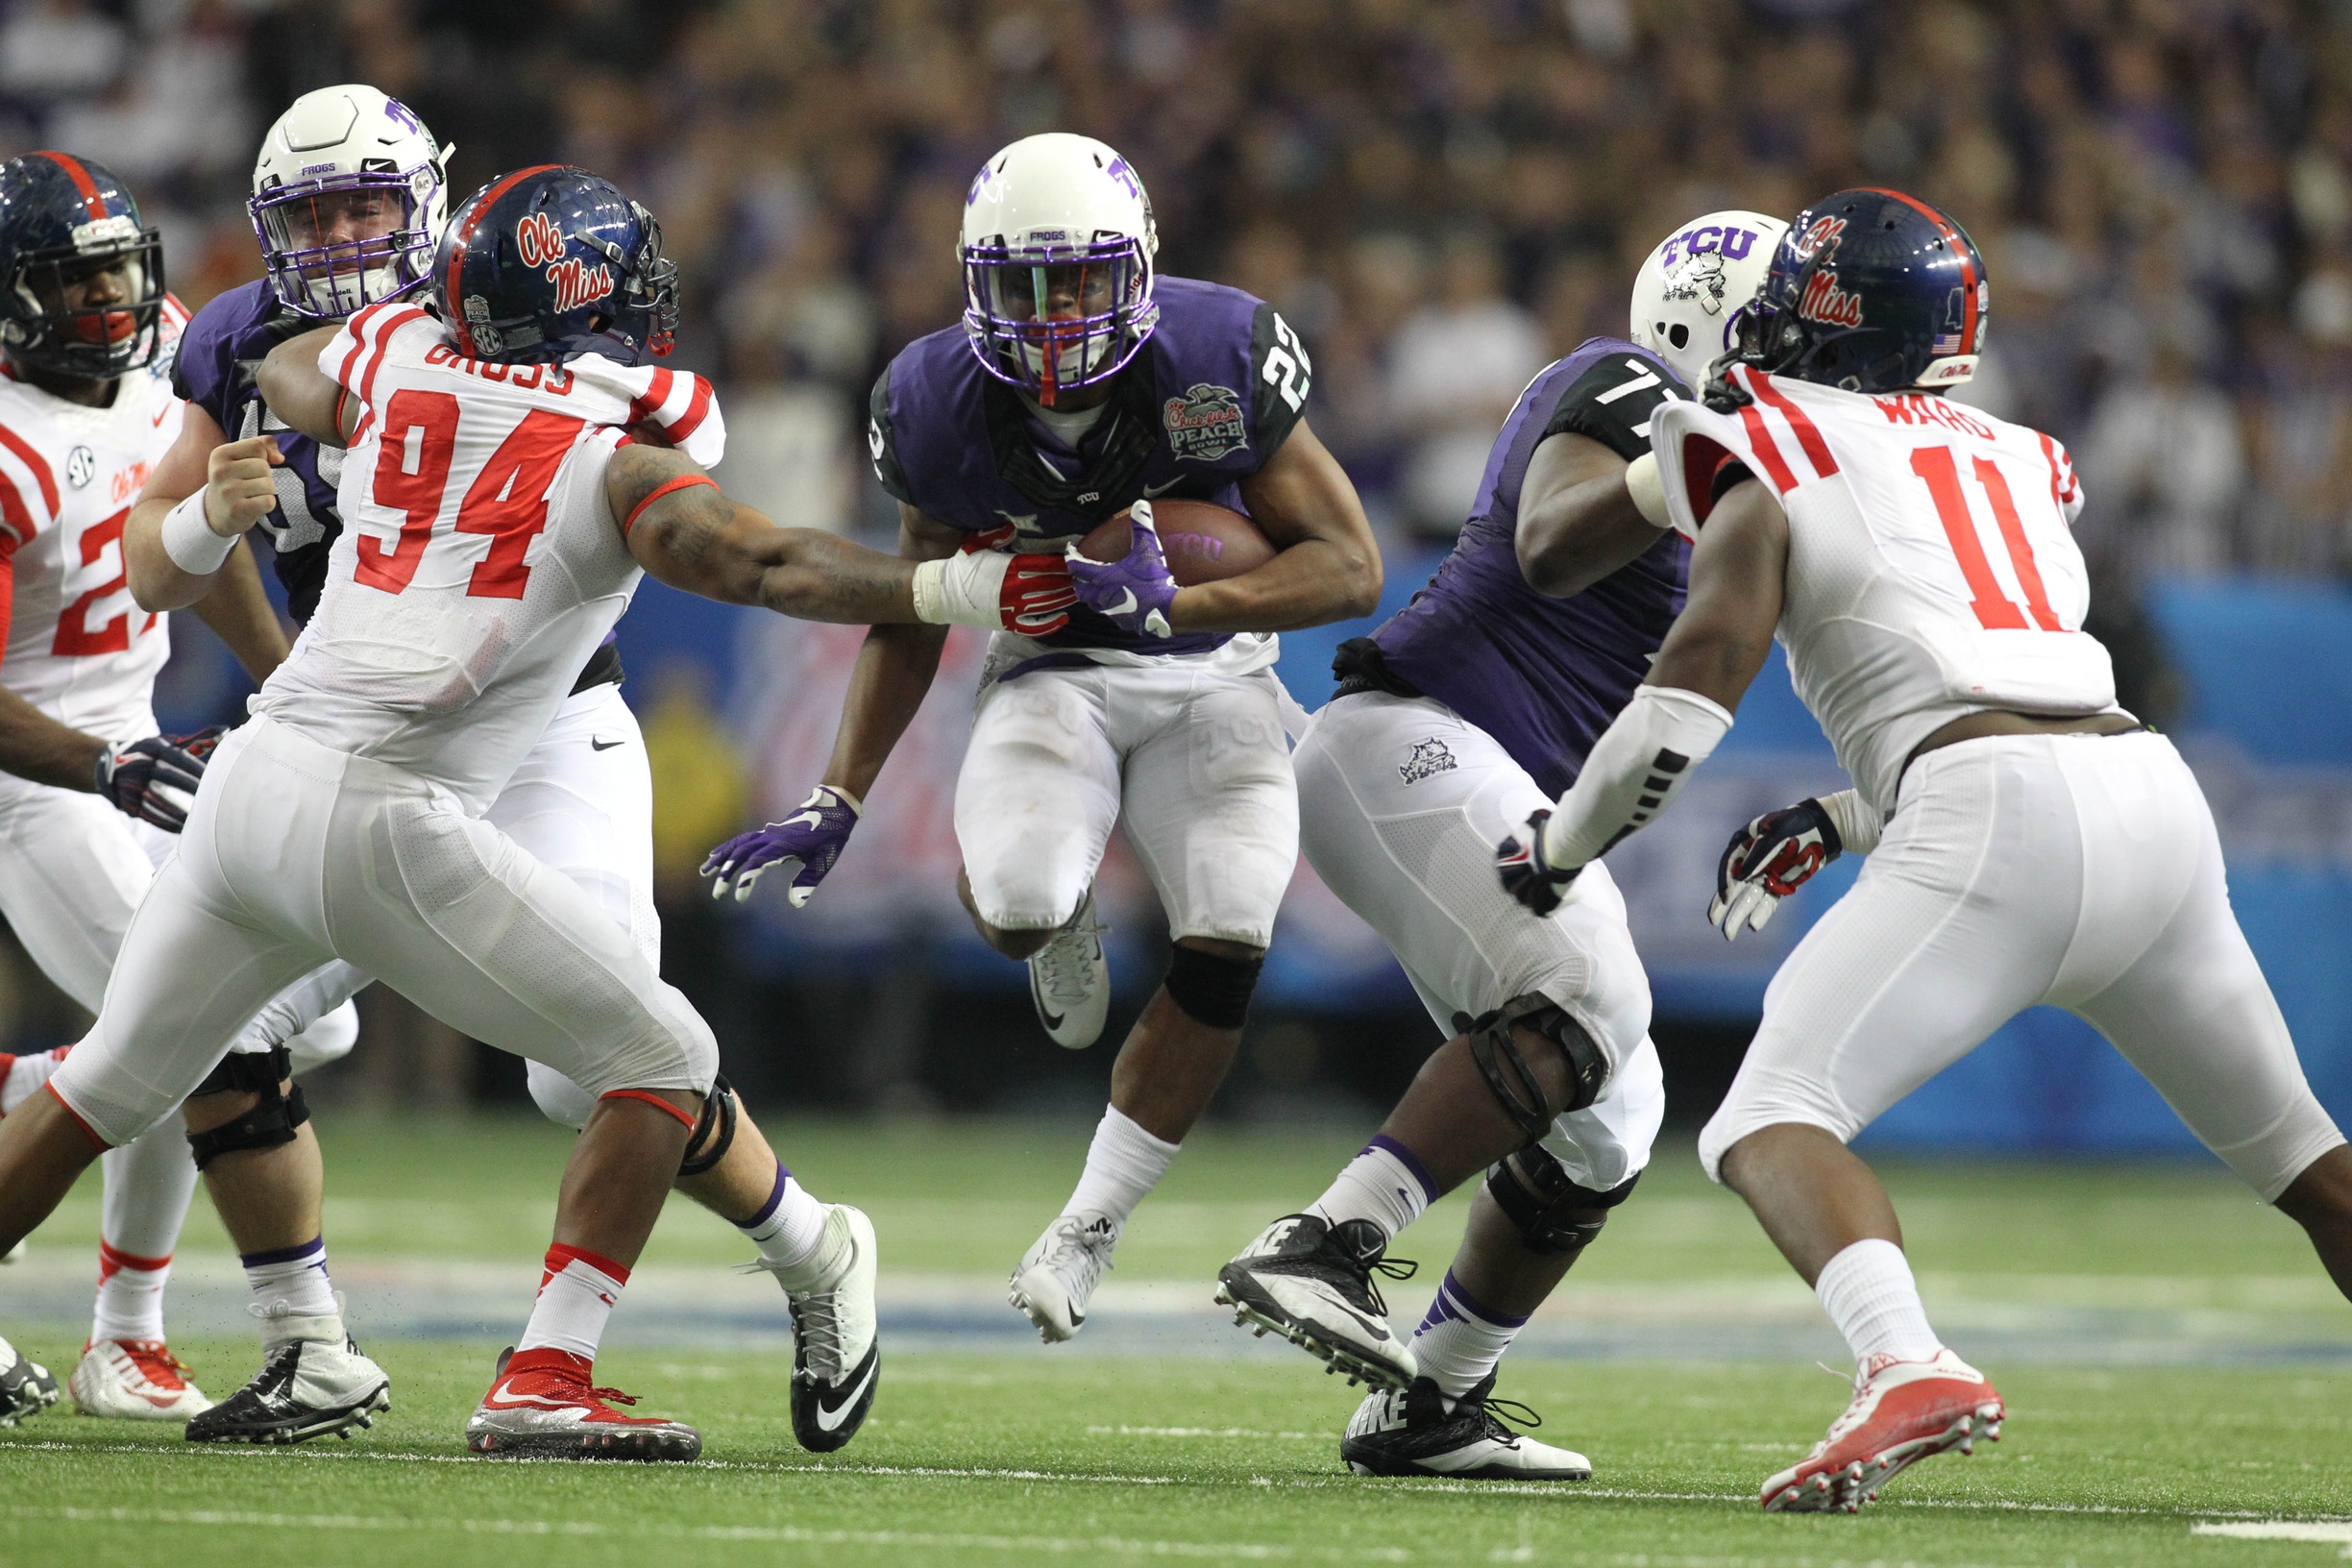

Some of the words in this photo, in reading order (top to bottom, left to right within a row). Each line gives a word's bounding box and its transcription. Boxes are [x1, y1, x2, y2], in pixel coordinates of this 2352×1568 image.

[302, 162, 336, 177] FROGS
[517, 211, 566, 269] Ole
[1030, 231, 1066, 242] FROGS
[1660, 226, 1758, 268] TCU
[327, 288, 353, 298] Ridell
[546, 257, 615, 314] Miss
[1799, 269, 1863, 328] Miss
[473, 326, 501, 354] SEC
[1870, 393, 2001, 441] WARD
[1172, 422, 1243, 449] PEACH
[1188, 438, 1228, 452] BOWL
[354, 388, 587, 600] 94
[1076, 491, 1100, 505] TCU
[1164, 532, 1224, 563] TCU
[1909, 446, 2071, 632] 11
